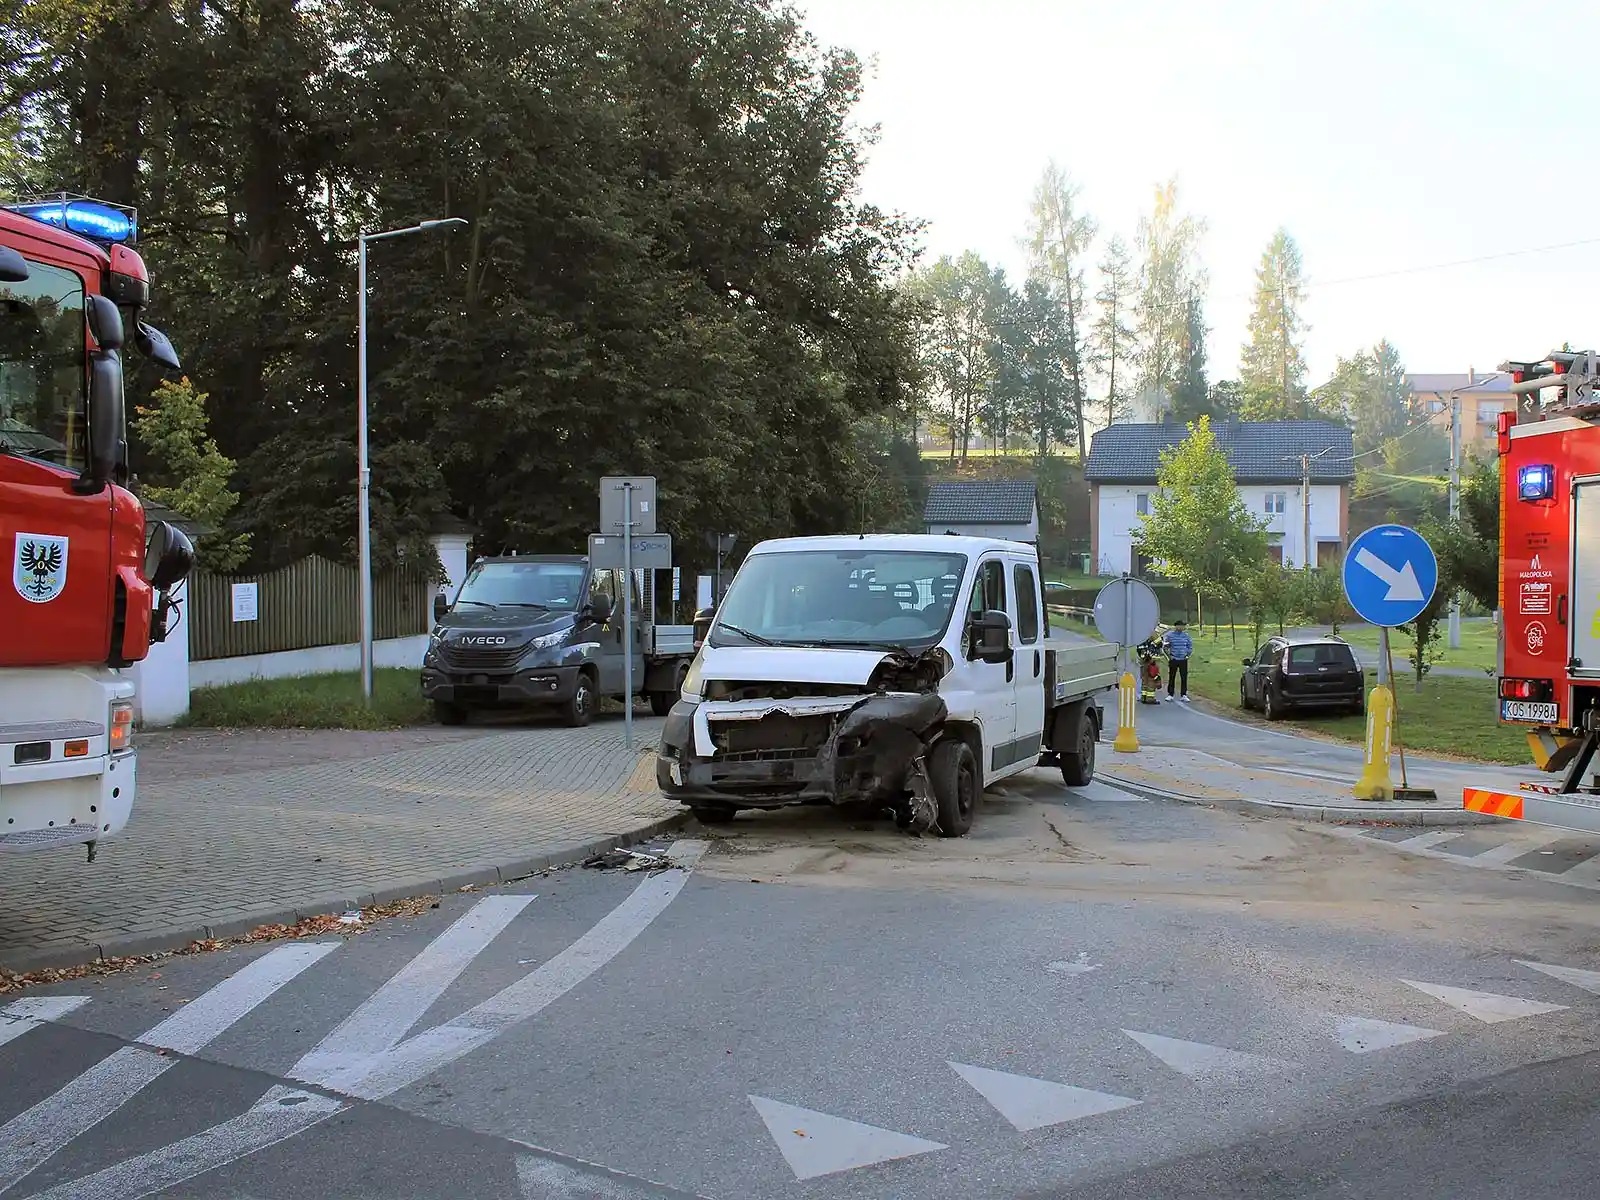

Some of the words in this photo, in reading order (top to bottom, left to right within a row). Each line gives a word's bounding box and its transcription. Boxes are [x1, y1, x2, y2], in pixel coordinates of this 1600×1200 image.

[461, 636, 506, 645] IVECO
[1507, 702, 1524, 717] KOS
[1528, 704, 1556, 719] 1998A
